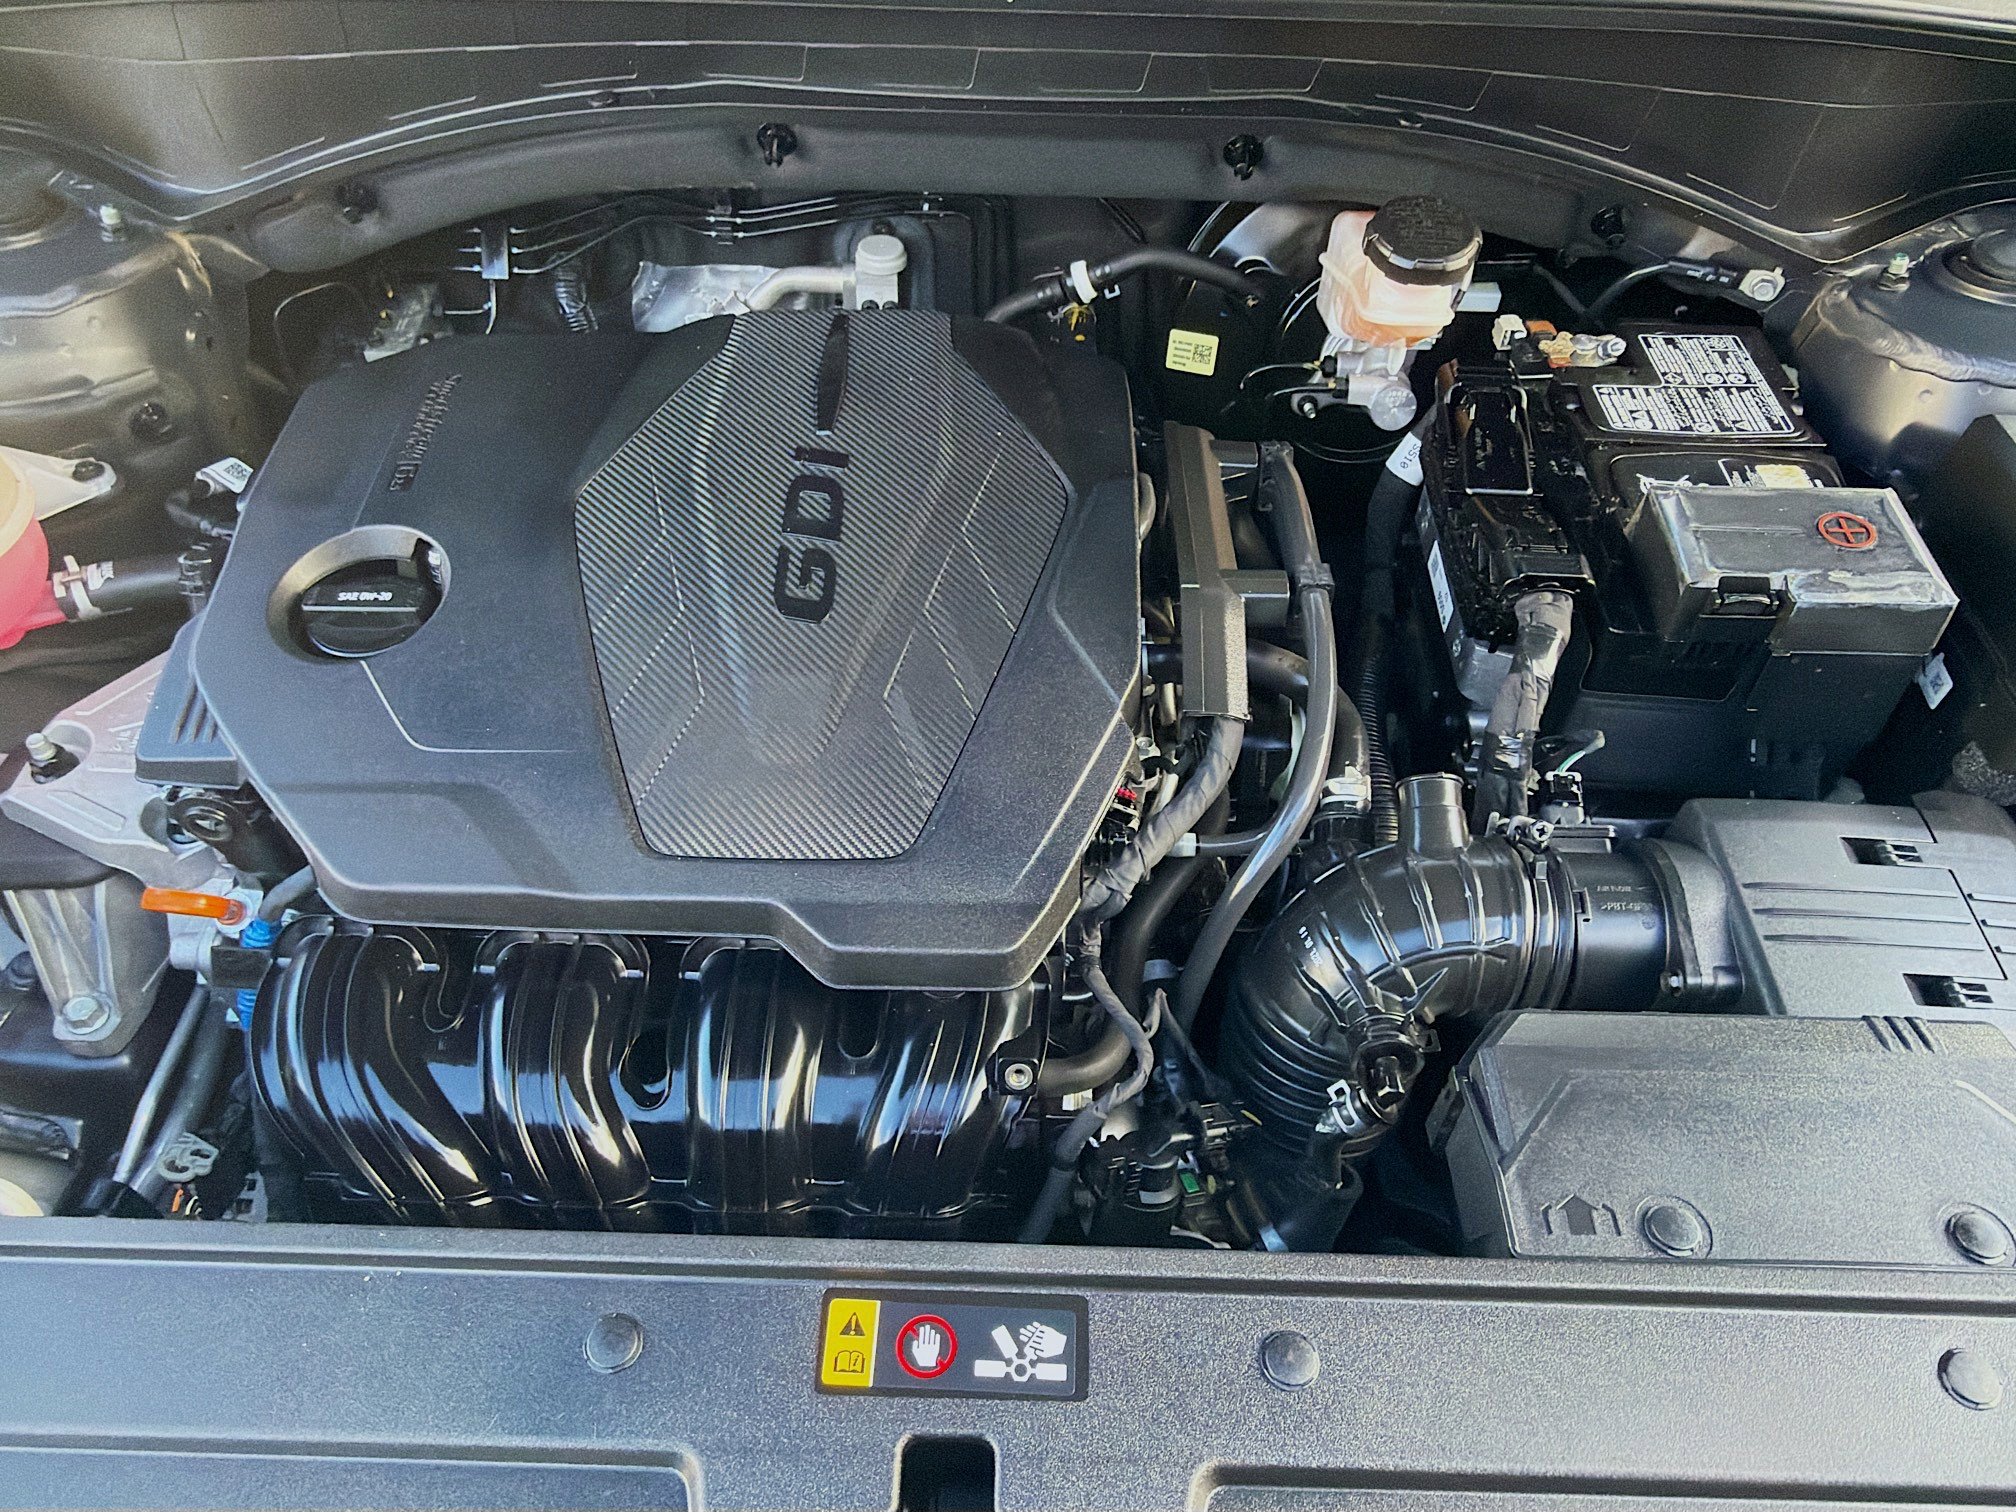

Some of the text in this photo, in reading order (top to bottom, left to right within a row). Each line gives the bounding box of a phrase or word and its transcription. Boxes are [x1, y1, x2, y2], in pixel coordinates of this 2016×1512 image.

[773, 445, 850, 625] GDI
[337, 592, 393, 602] SAE 0W-20
